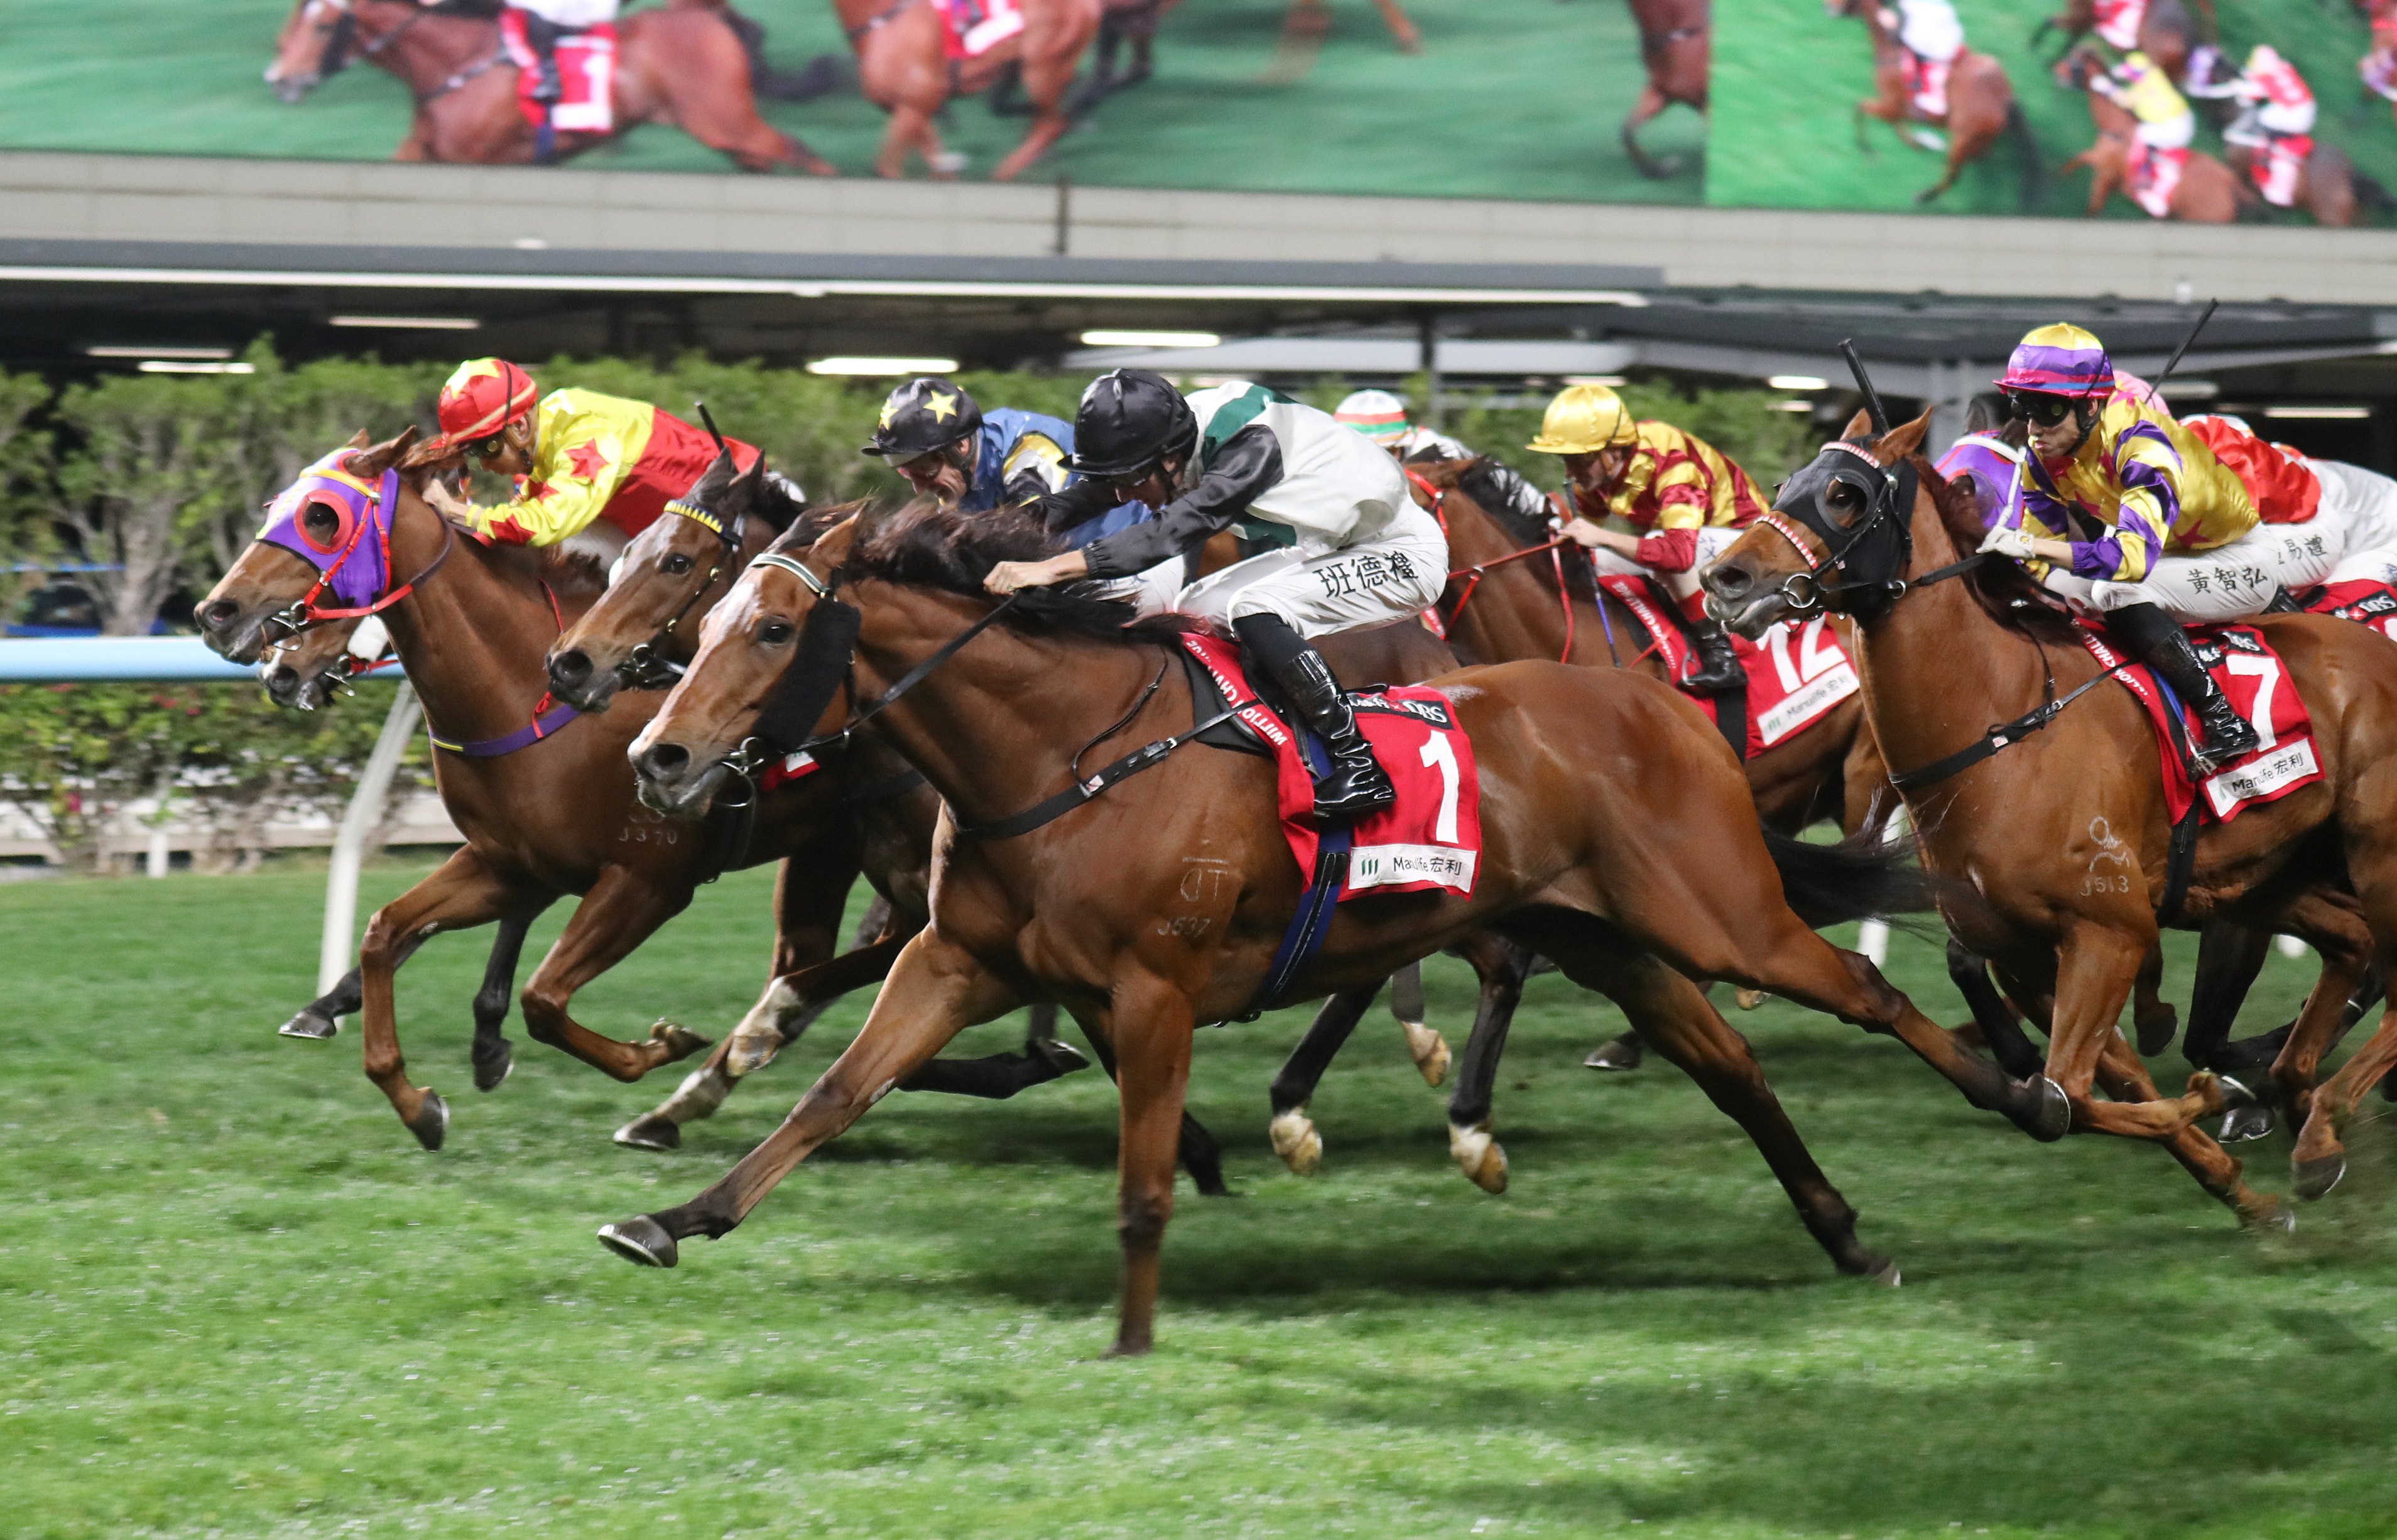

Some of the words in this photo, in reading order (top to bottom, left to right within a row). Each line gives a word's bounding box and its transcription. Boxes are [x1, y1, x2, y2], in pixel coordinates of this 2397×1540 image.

[2278, 534, 2327, 565] 易禮
[1312, 550, 1418, 598] 班德禮
[2187, 567, 2268, 594] 黃智弘
[1402, 701, 1447, 723] DBS
[2226, 654, 2281, 753] 7
[2273, 752, 2304, 776] 宏利
[1419, 730, 1460, 845] 1
[1429, 857, 1462, 876] 宏利
[2080, 875, 2129, 896] J513
